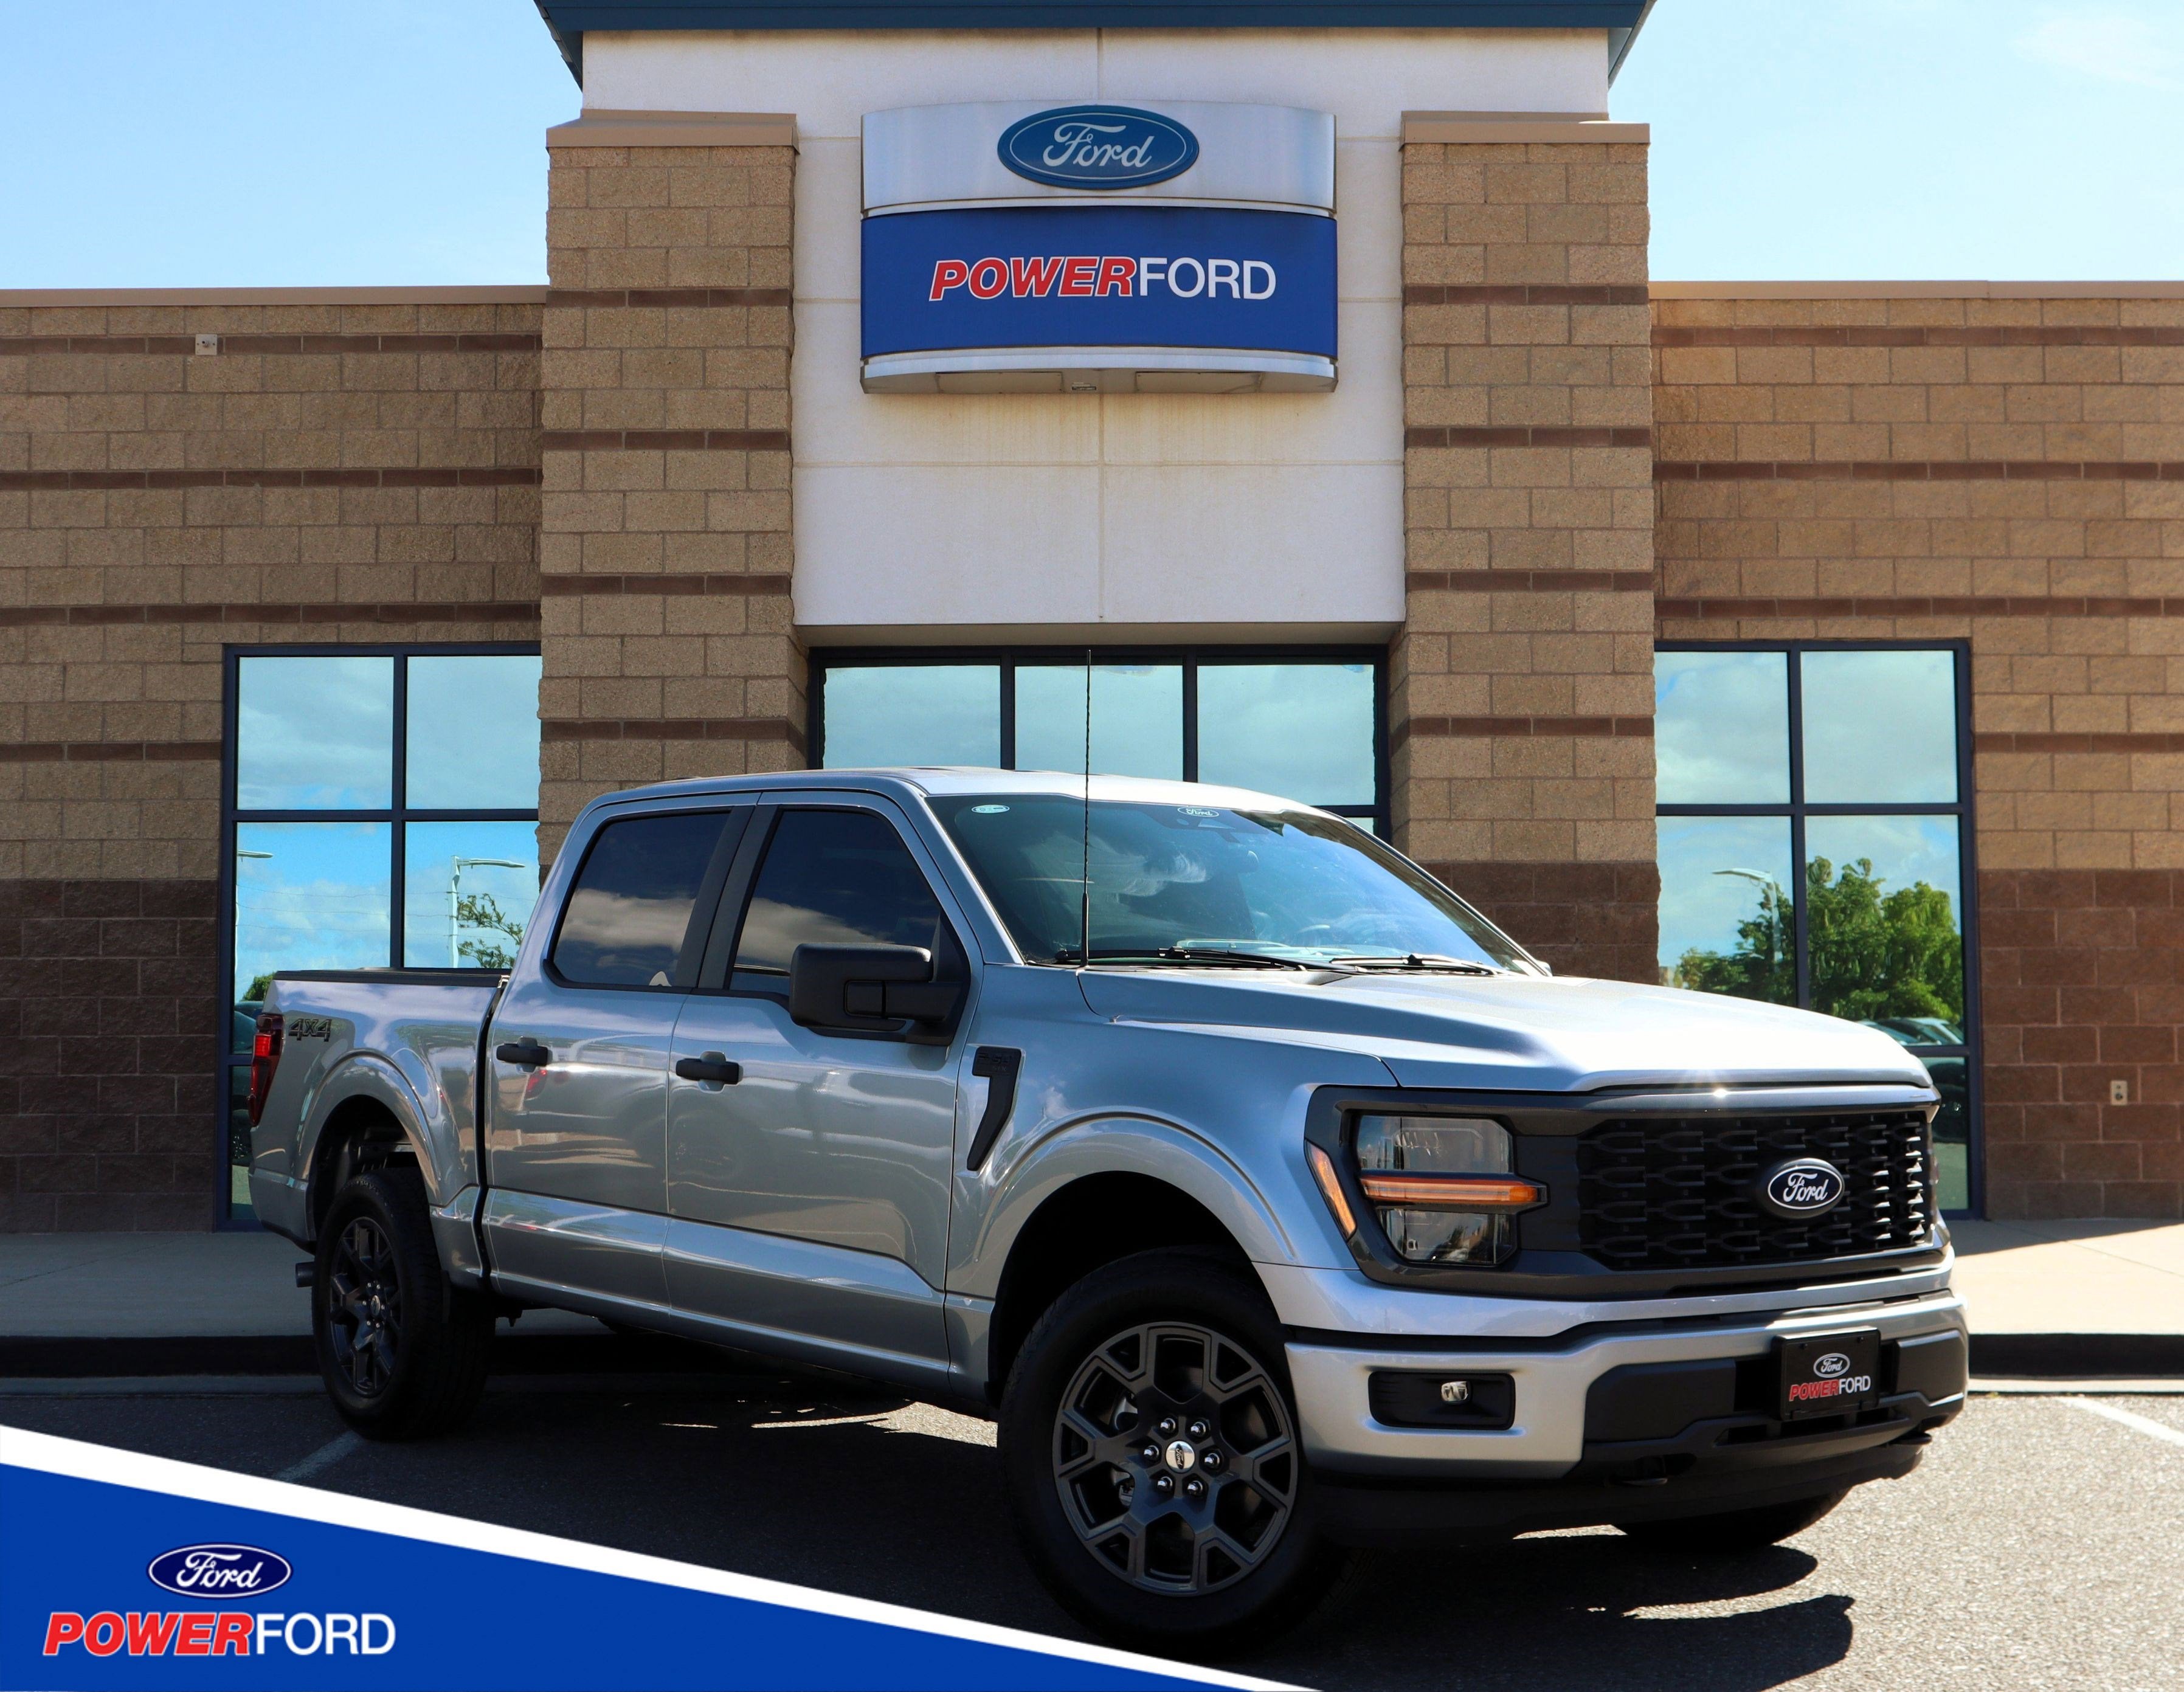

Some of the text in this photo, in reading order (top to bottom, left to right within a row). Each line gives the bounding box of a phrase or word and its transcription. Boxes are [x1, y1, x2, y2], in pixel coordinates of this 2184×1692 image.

[1042, 122, 1154, 167] Ford
[929, 256, 1276, 301] POWERFORD
[1783, 1172, 1830, 1203] Ford
[1822, 1358, 1842, 1373] Ford
